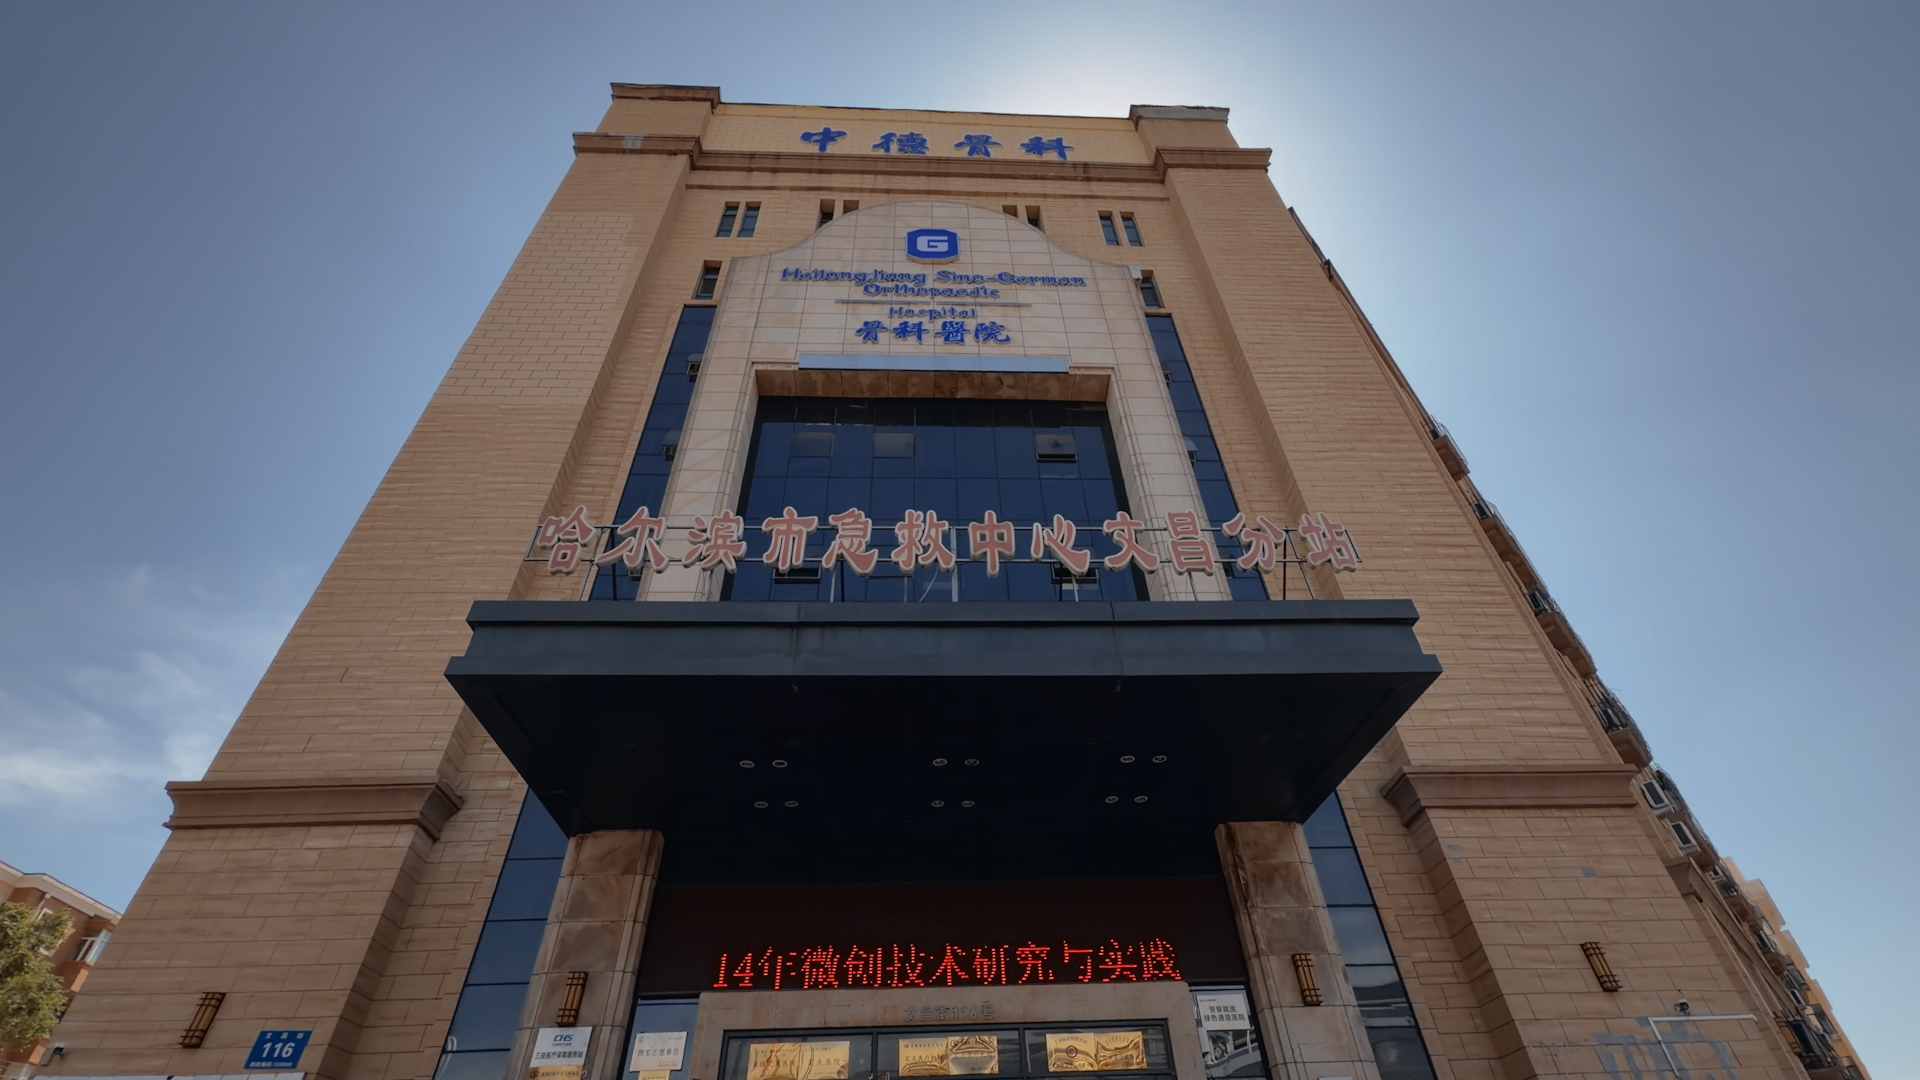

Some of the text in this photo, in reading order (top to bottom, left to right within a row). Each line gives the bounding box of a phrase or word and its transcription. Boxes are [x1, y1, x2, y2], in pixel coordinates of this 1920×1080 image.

[800, 126, 1075, 161] 中德骨科
[934, 269, 1087, 287] Sino-German
[862, 283, 1000, 300] Orthopaedic
[887, 306, 977, 323] Hospital
[855, 320, 1012, 345] 骨科醫院
[535, 504, 1361, 578] 哈尔滨市急救中心文昌分站
[261, 1041, 296, 1058] 116
